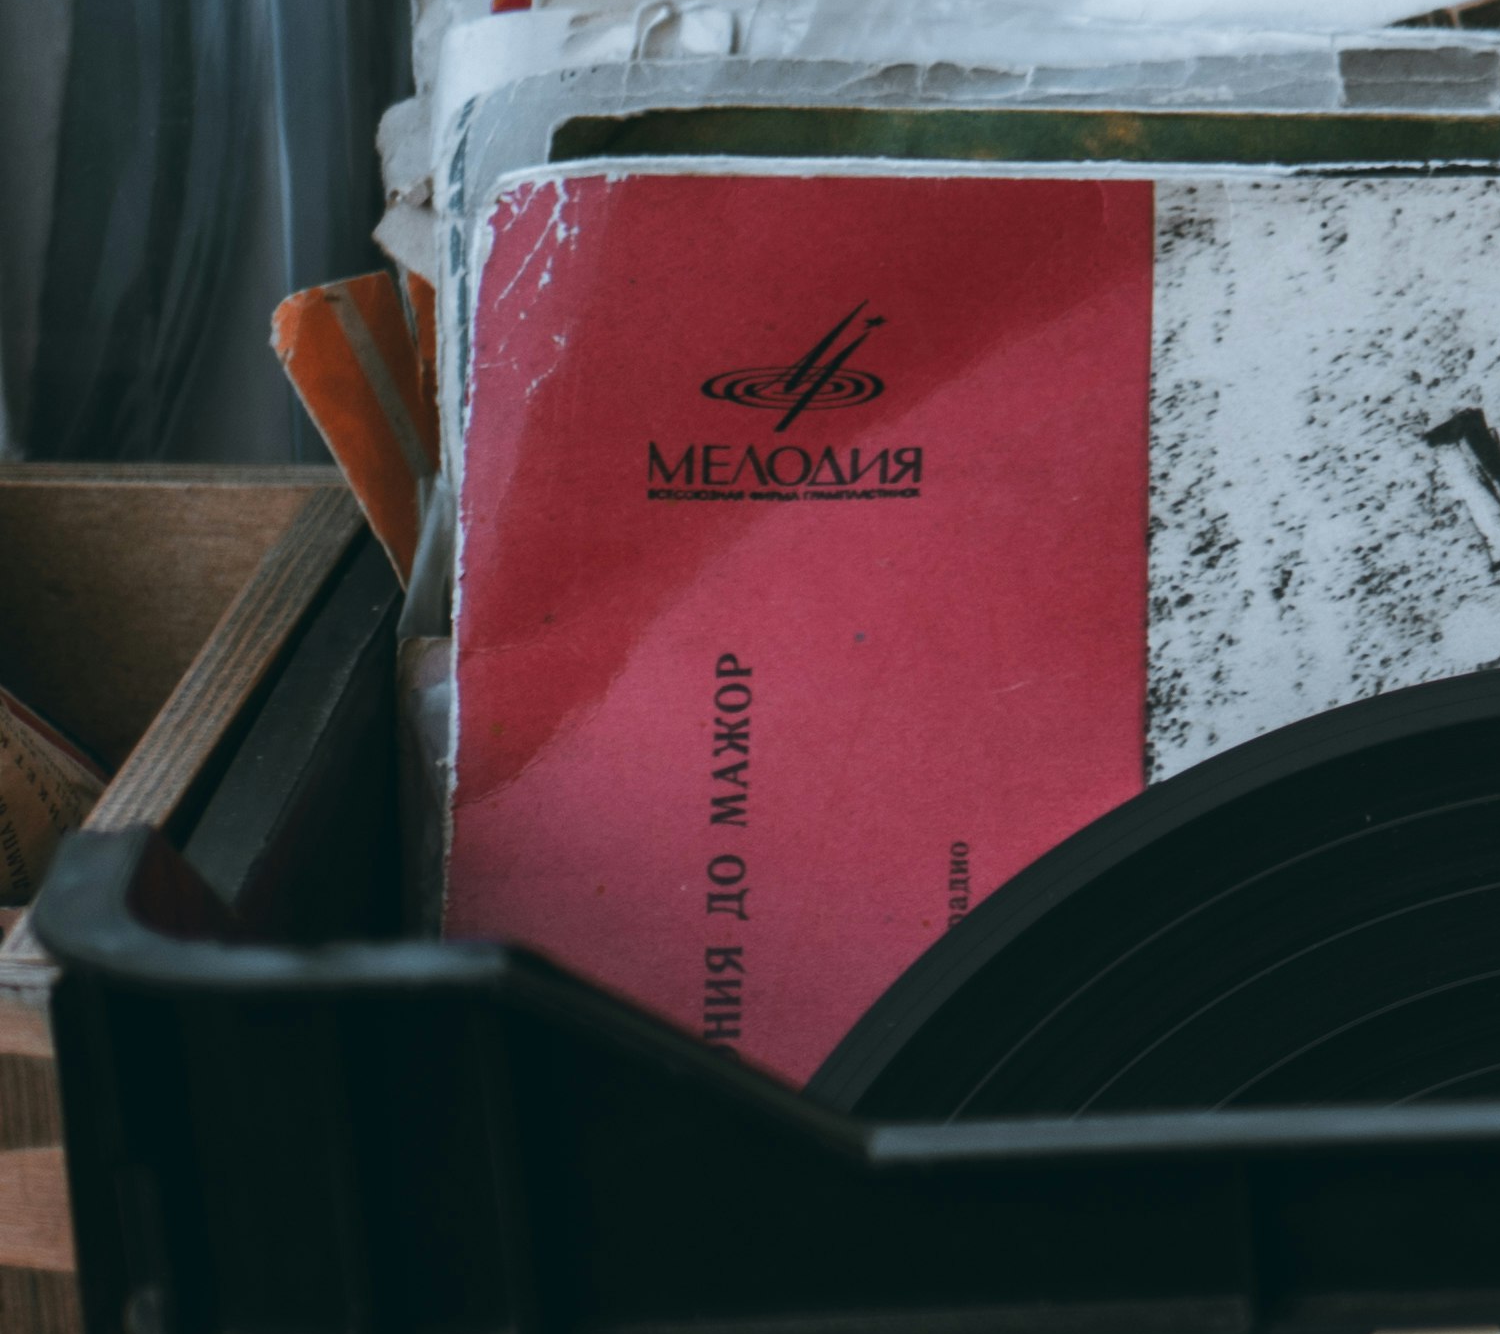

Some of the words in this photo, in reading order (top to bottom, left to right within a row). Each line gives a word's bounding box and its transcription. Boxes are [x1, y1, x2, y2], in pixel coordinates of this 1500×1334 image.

[647, 441, 923, 486] МЕЛОДИЯ
[710, 651, 755, 830] МАЖОР
[704, 852, 750, 924] ДО
